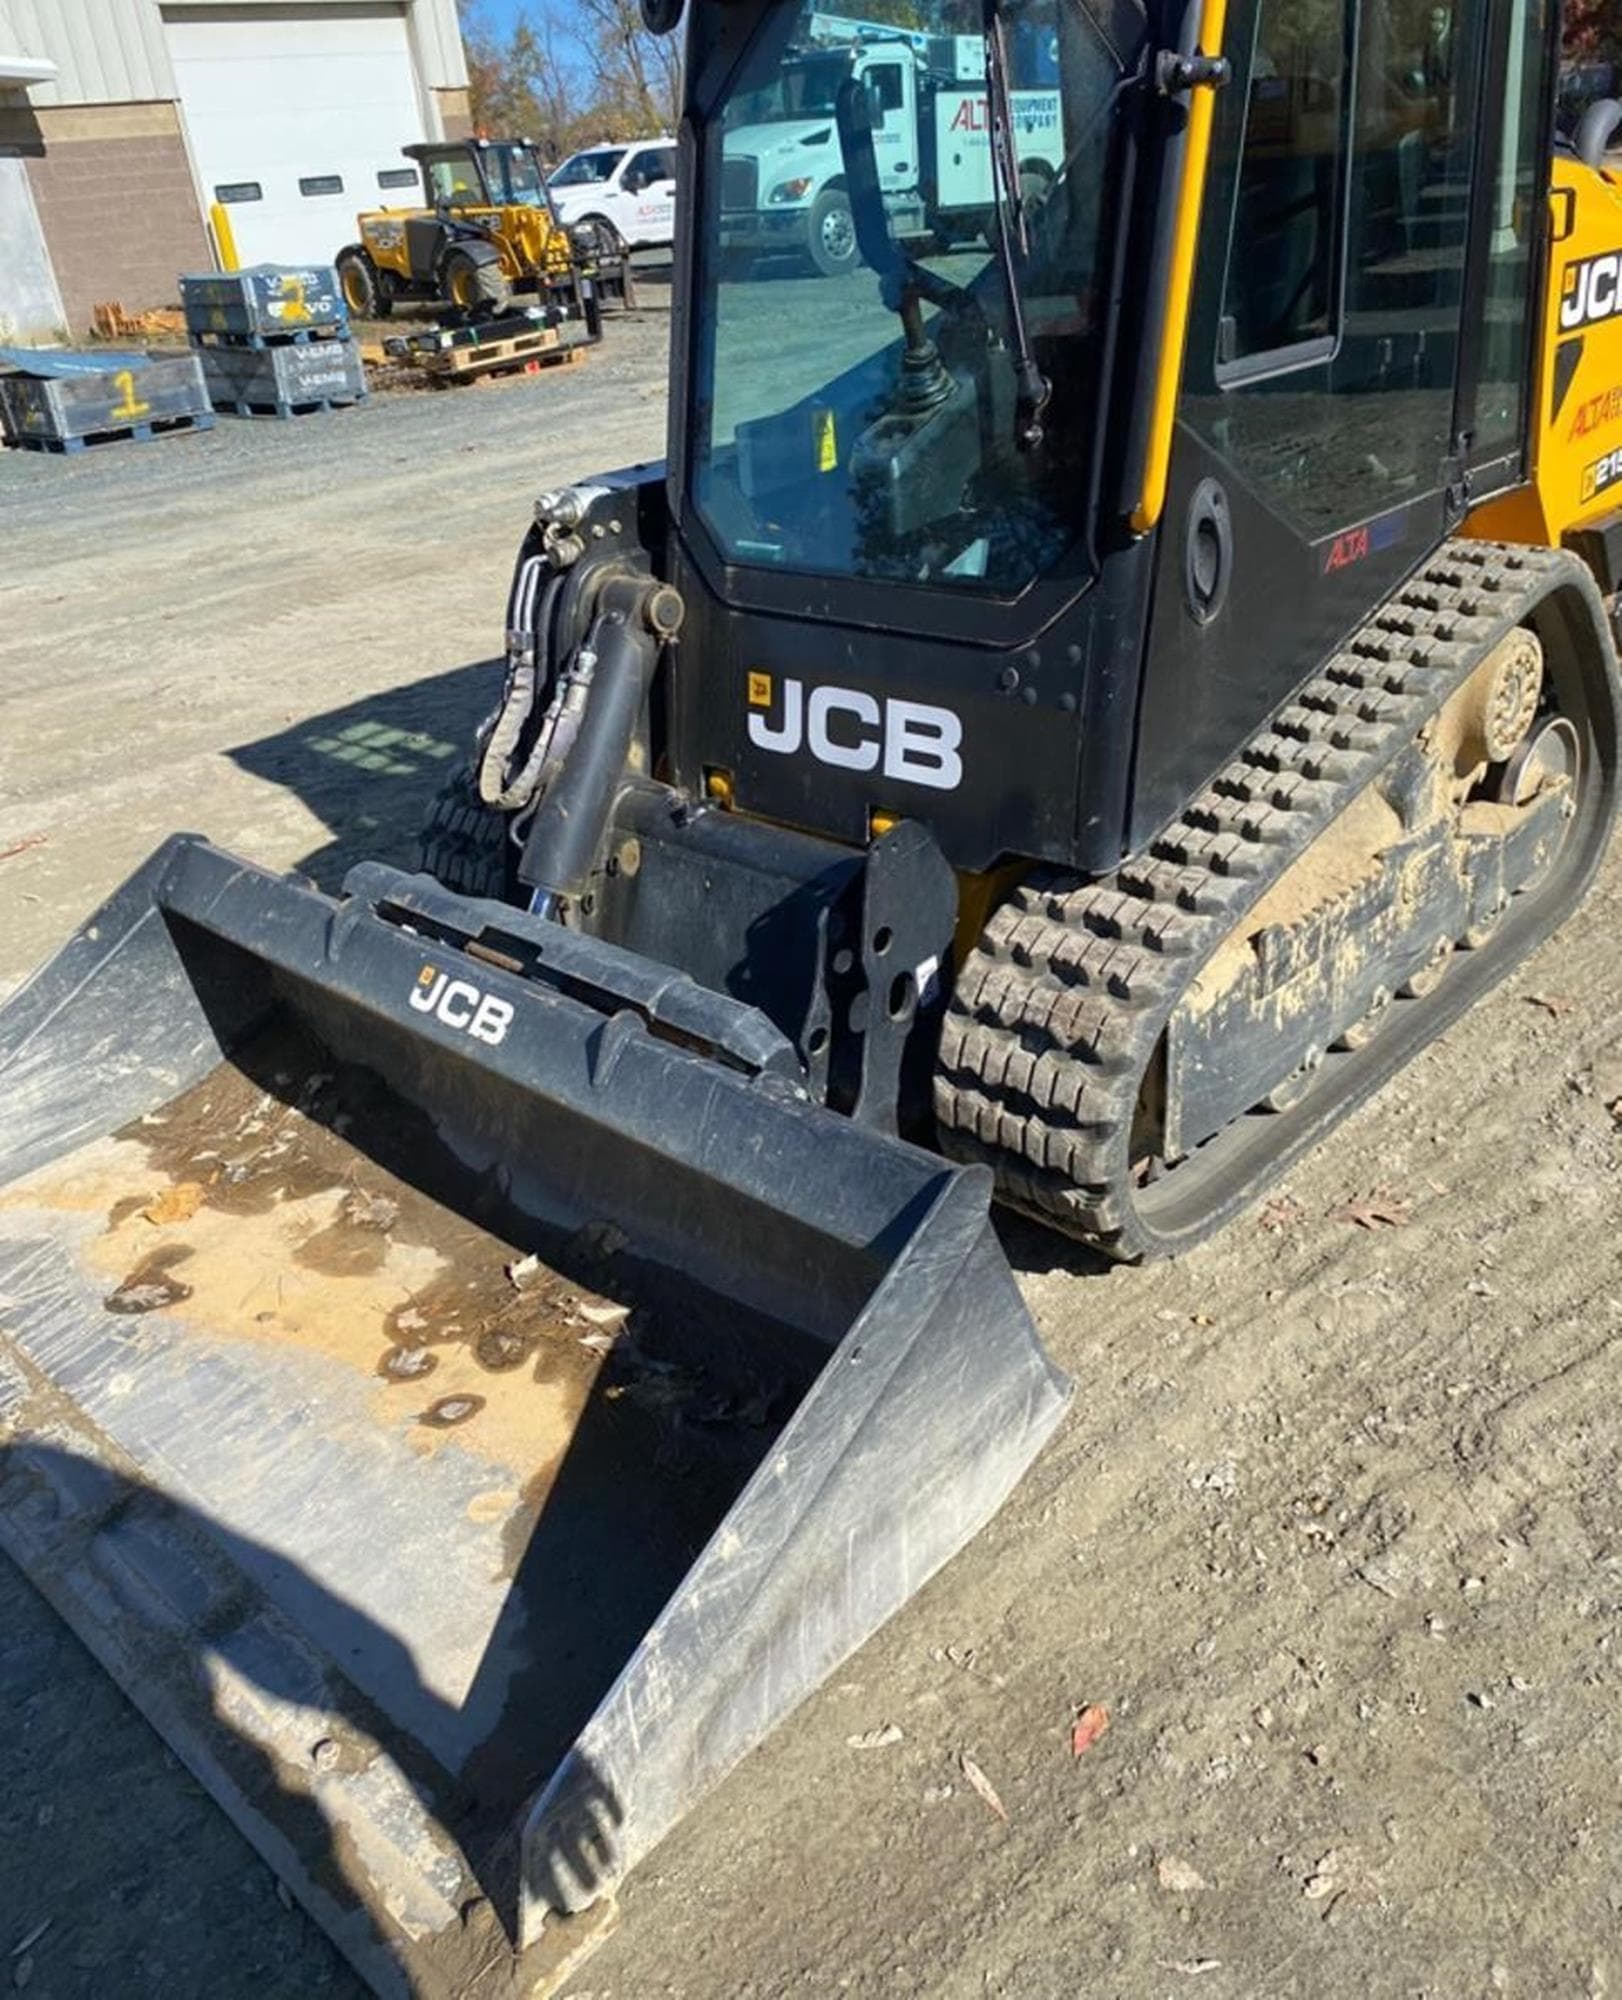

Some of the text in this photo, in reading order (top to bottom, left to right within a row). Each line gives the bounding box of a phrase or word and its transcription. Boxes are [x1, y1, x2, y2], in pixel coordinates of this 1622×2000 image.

[949, 99, 990, 132] ALT
[110, 369, 149, 418] 1
[1323, 526, 1369, 575] ALTA
[747, 678, 963, 790] JCB
[409, 972, 515, 1046] JCB
